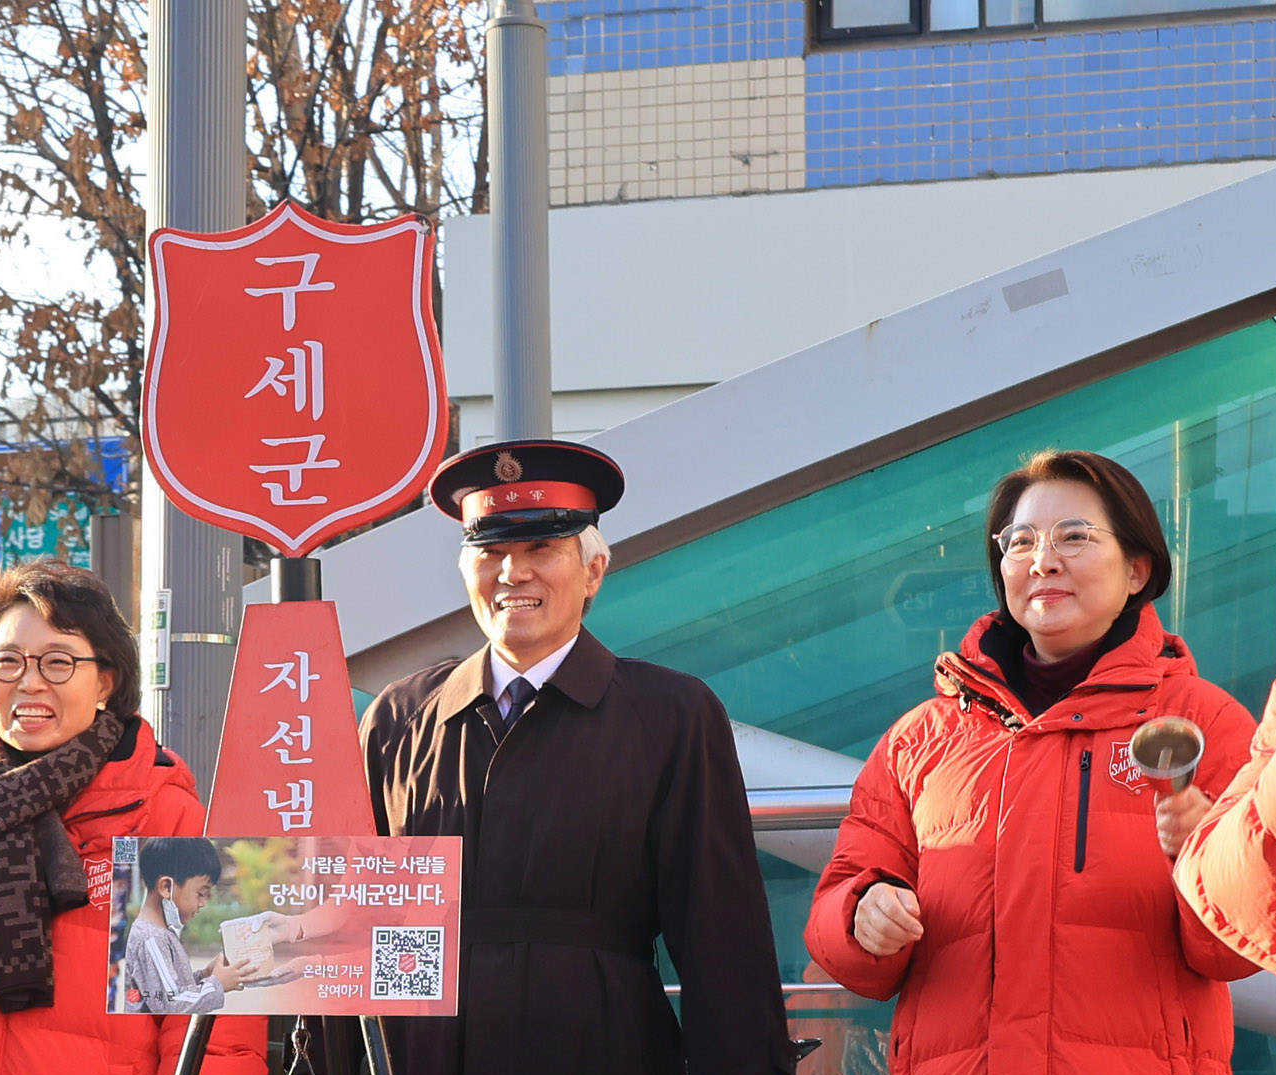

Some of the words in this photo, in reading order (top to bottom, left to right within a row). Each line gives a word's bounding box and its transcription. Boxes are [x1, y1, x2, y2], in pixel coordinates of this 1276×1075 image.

[244, 253, 342, 506] 구세군
[260, 651, 320, 832] 자선냄
[1118, 746, 1132, 759] TH
[88, 862, 108, 877] THE
[301, 856, 348, 875] 사람을
[351, 856, 397, 875] 구하는
[399, 856, 446, 875] 사람들
[90, 884, 111, 900] ARM
[269, 883, 324, 907] 당신이
[328, 883, 446, 907] 구세군입니다.
[302, 964, 339, 979] 온라인
[340, 964, 365, 979] 기부
[143, 990, 176, 1002] 구세군
[317, 983, 364, 998] 참여하기
